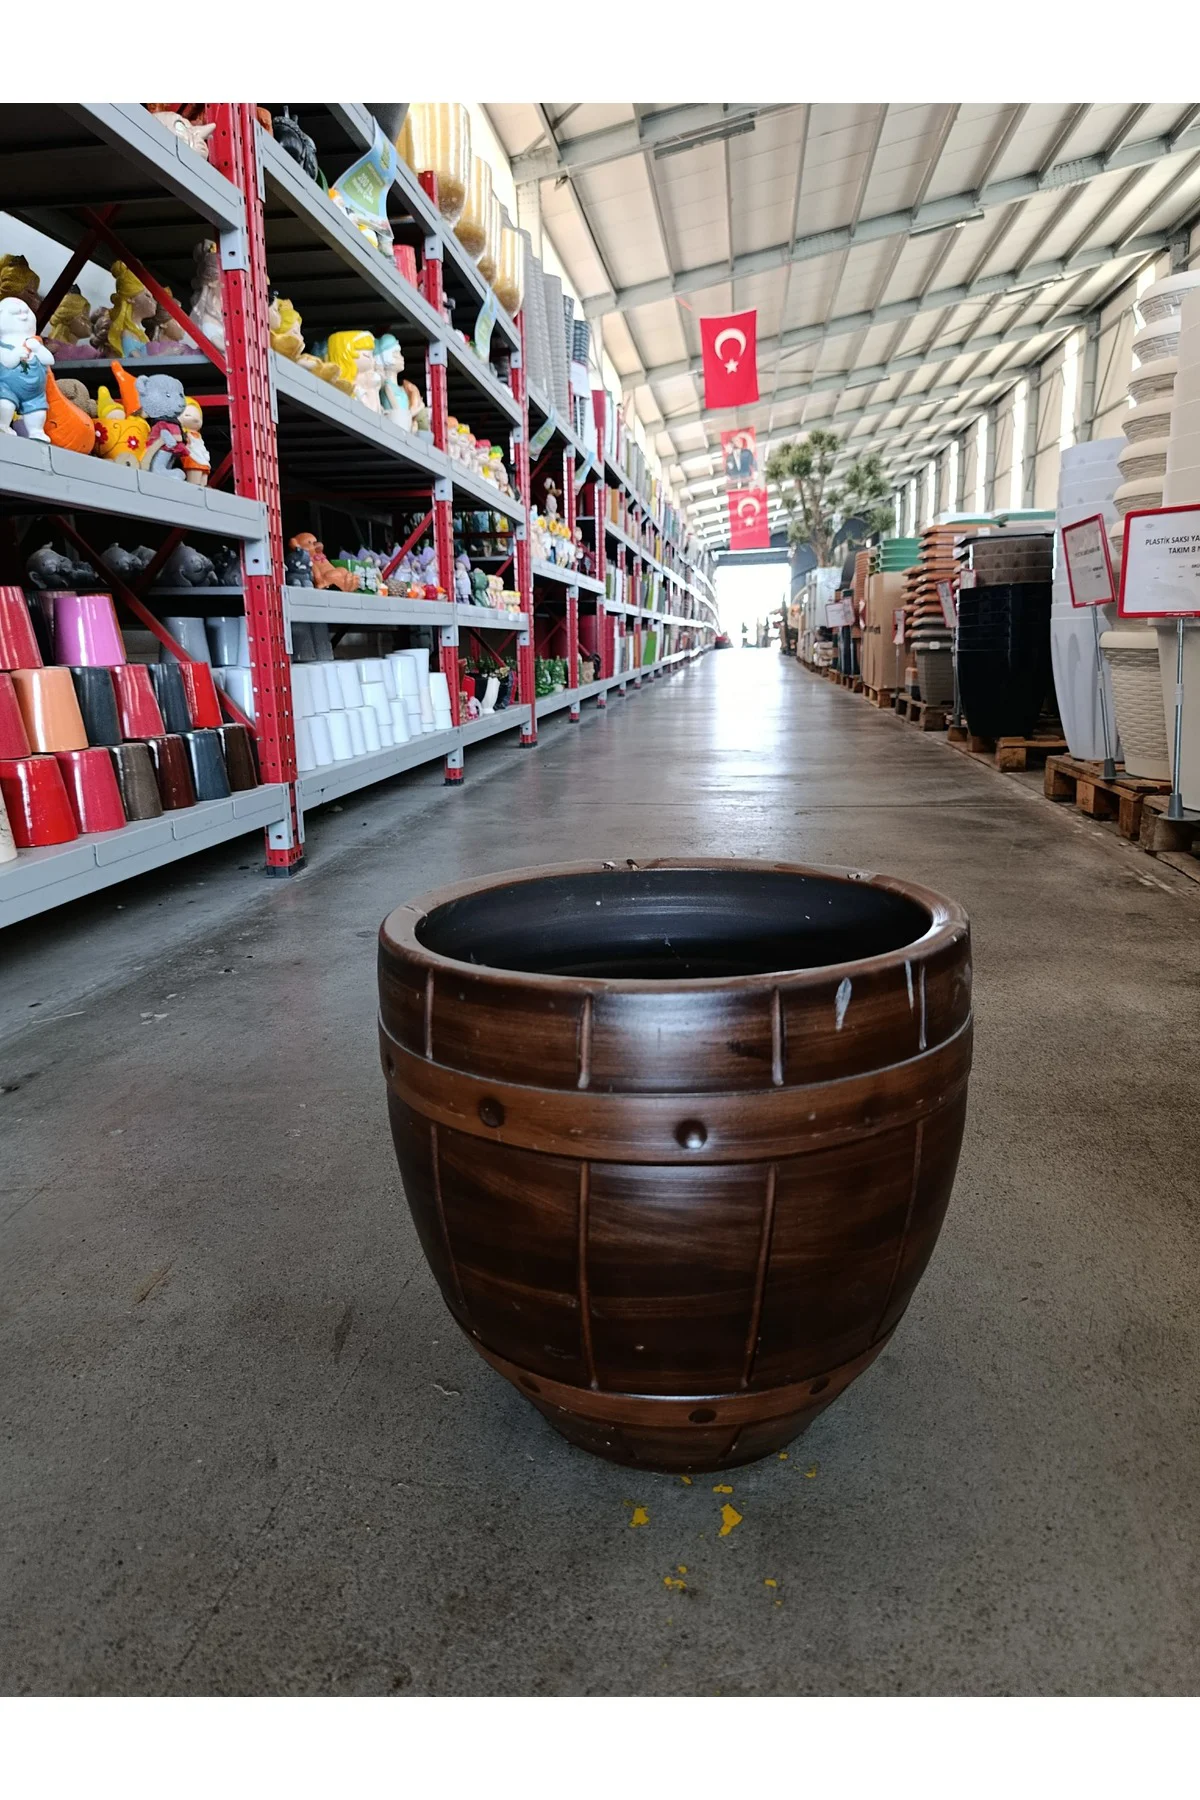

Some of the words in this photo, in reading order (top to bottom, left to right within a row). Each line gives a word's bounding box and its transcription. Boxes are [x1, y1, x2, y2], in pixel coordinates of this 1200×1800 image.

[1145, 536, 1170, 546] PLASTİK
[1171, 535, 1190, 544] SAKSI
[1168, 546, 1190, 554] TAKIM
[1191, 545, 1197, 553] 8
